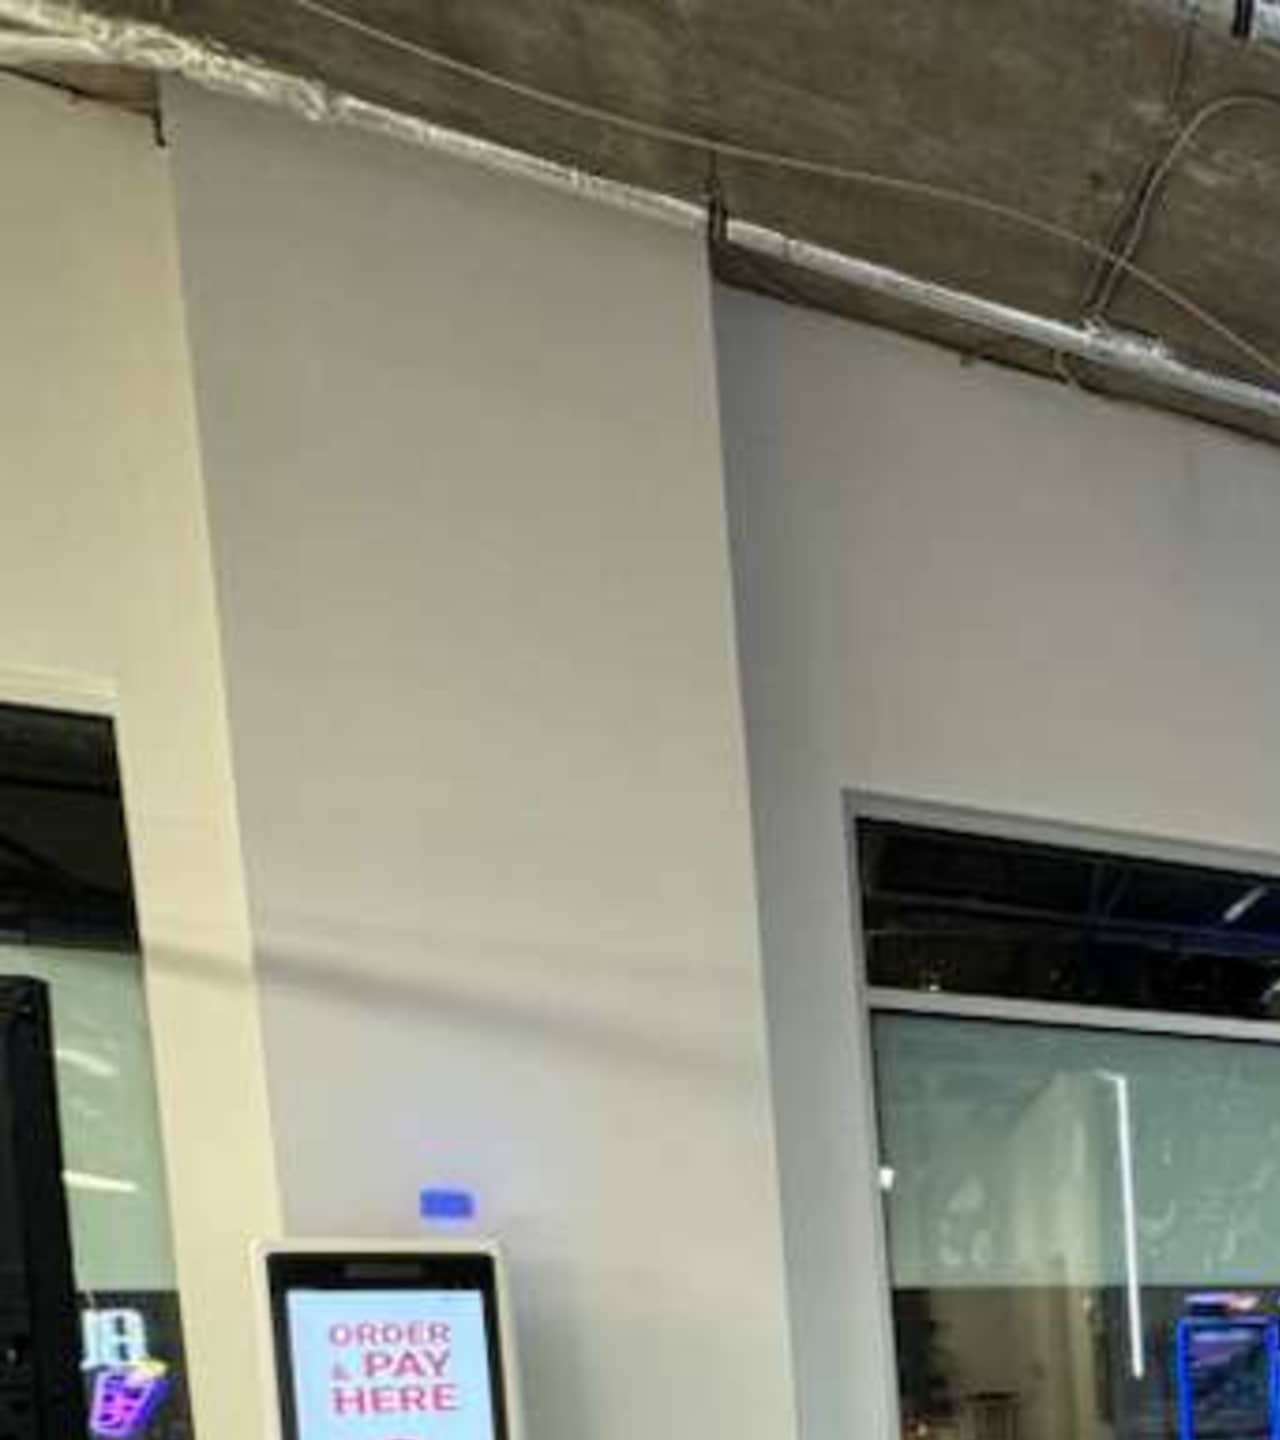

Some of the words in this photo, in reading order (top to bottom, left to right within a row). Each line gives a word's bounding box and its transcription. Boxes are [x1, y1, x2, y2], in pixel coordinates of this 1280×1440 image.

[329, 1320, 452, 1347] ORDER
[364, 1350, 451, 1378] PAY
[332, 1383, 461, 1415] HERE
